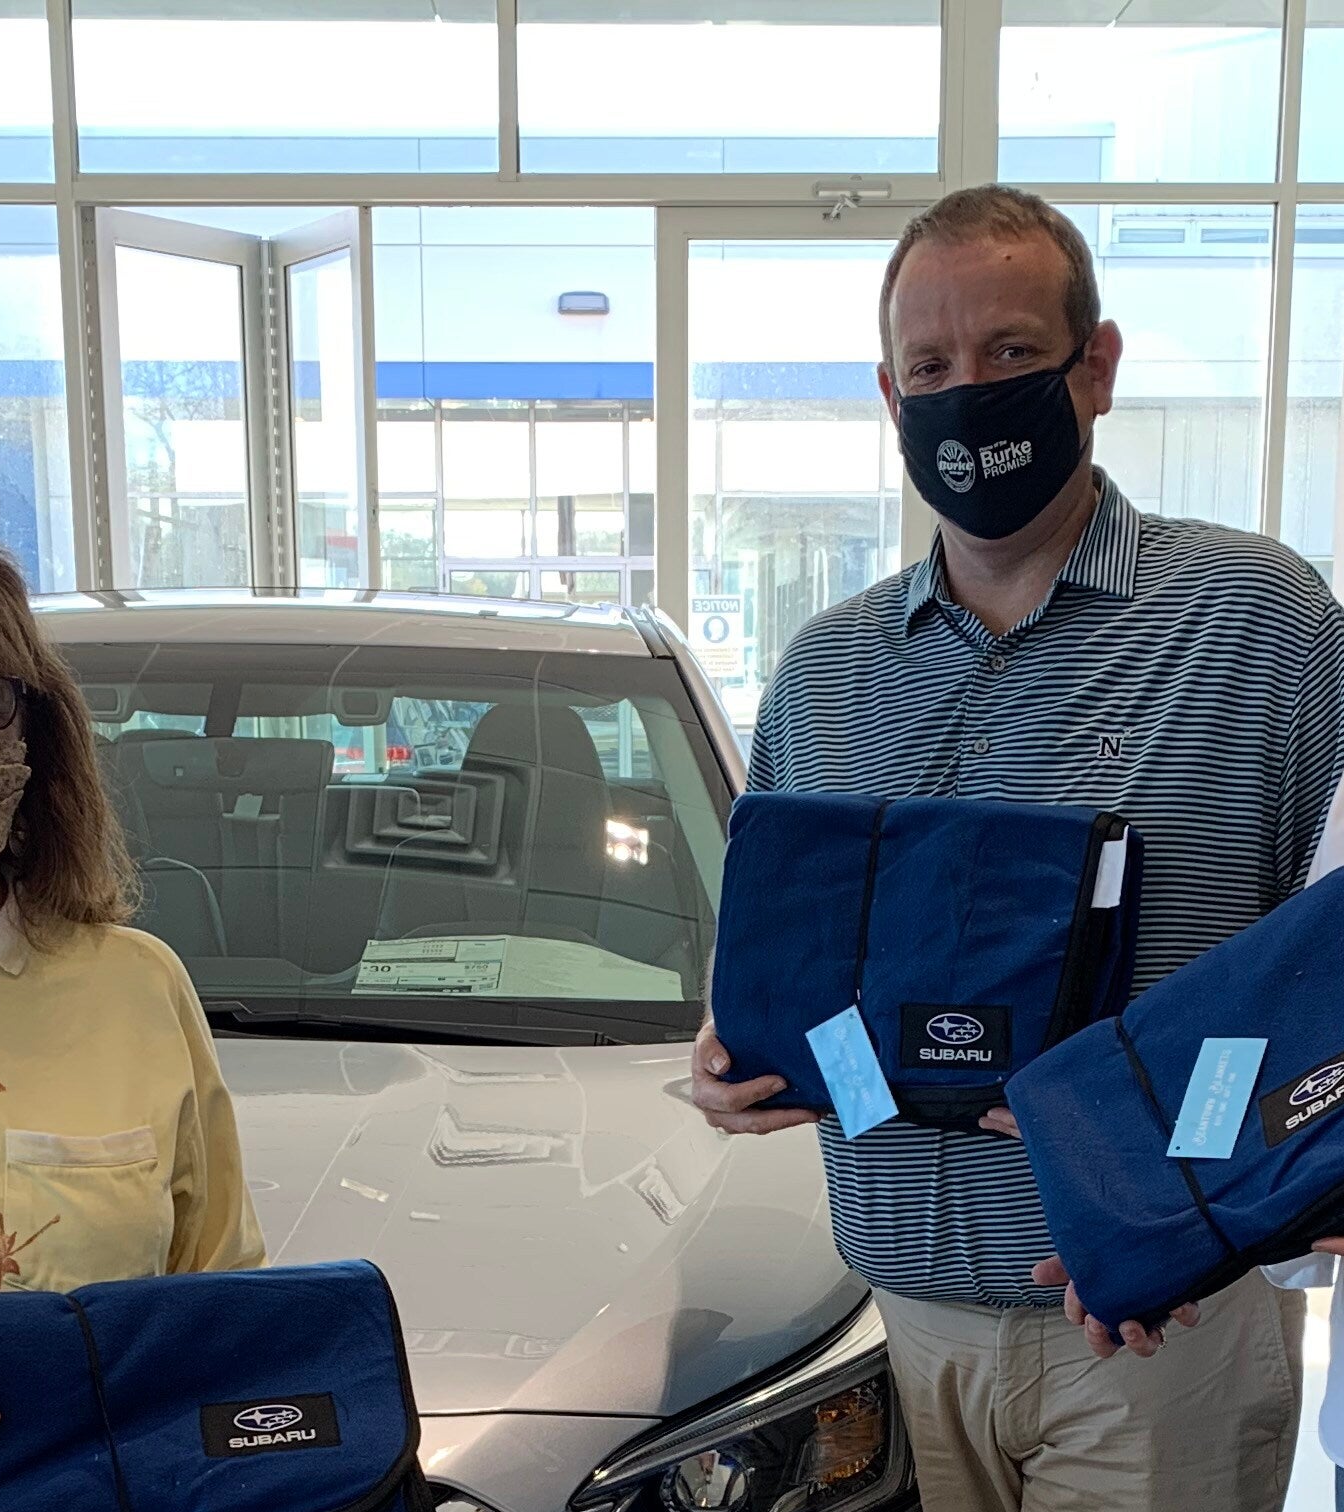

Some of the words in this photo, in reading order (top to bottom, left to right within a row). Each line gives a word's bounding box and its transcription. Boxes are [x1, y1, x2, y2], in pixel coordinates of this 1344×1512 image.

[980, 440, 1032, 469] Burke
[983, 451, 1033, 479] PROMISE
[939, 460, 974, 471] Burke
[1098, 735, 1124, 758] N
[369, 965, 392, 973] 30
[919, 1048, 993, 1062] SUBARU
[228, 1428, 317, 1449] SUBARU
